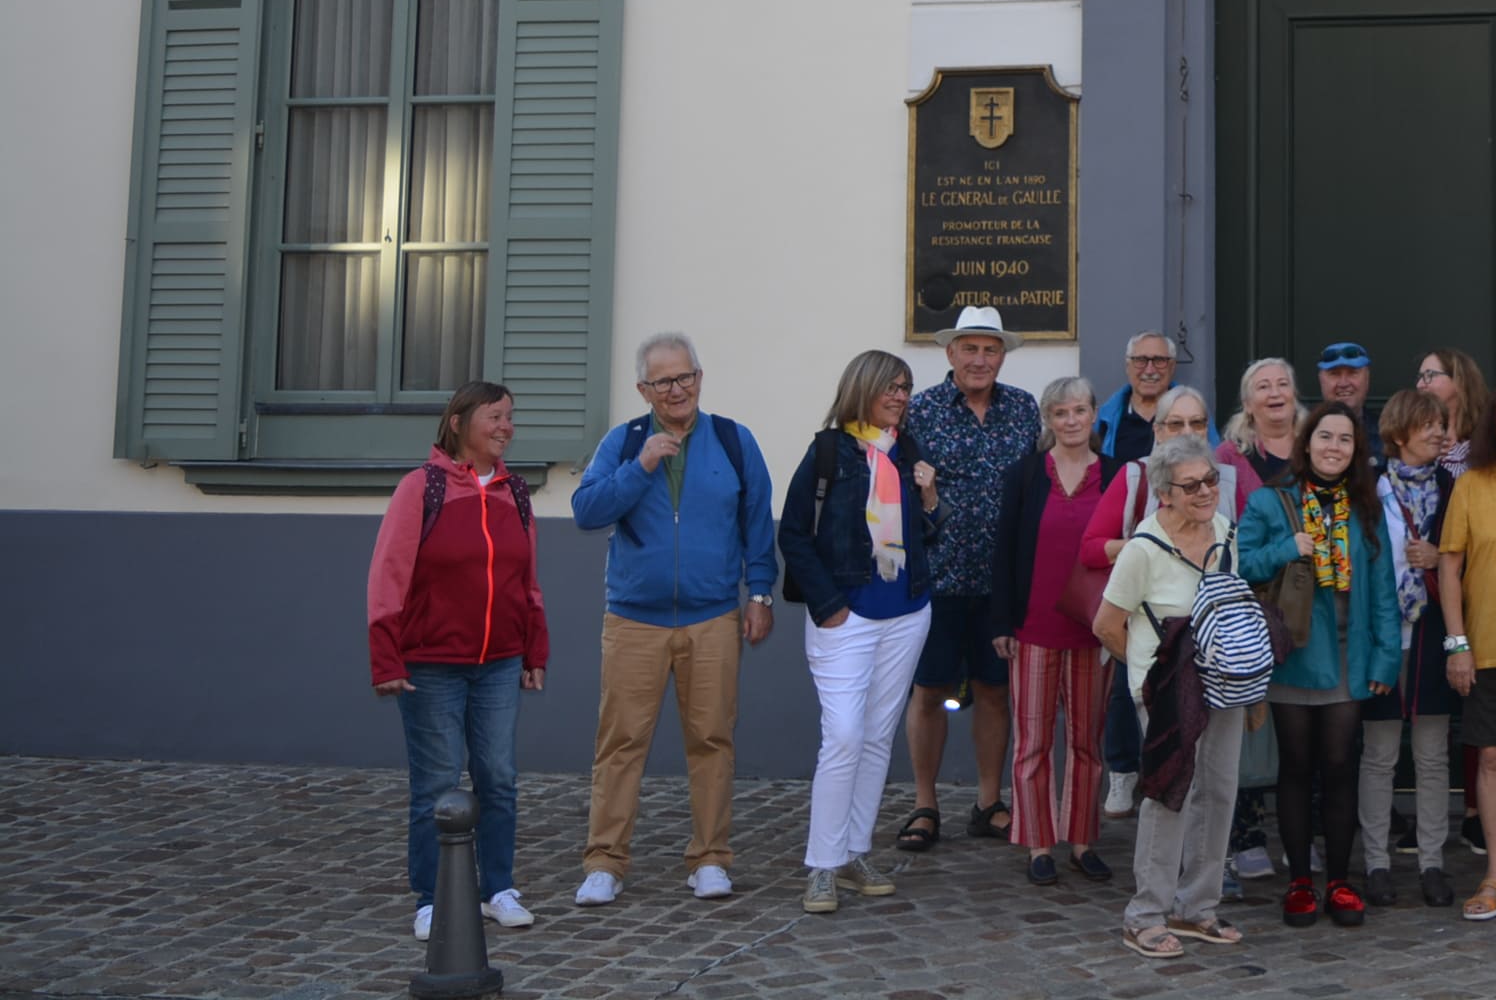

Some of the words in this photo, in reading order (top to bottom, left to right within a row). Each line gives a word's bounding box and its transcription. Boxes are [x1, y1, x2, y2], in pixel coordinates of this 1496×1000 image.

[984, 160, 1000, 170] ICI
[937, 176, 955, 186] EST
[978, 175, 991, 185] EN
[1024, 175, 1046, 185] 1890
[921, 192, 937, 207] LE
[1012, 189, 1062, 205] GAULLE
[942, 221, 1008, 231] PROMOTEUR
[1010, 220, 1023, 230] DE
[1027, 219, 1040, 230] LA
[952, 261, 986, 276] JUIN
[990, 260, 1030, 278] 1940
[1020, 290, 1065, 306] PATRIE
